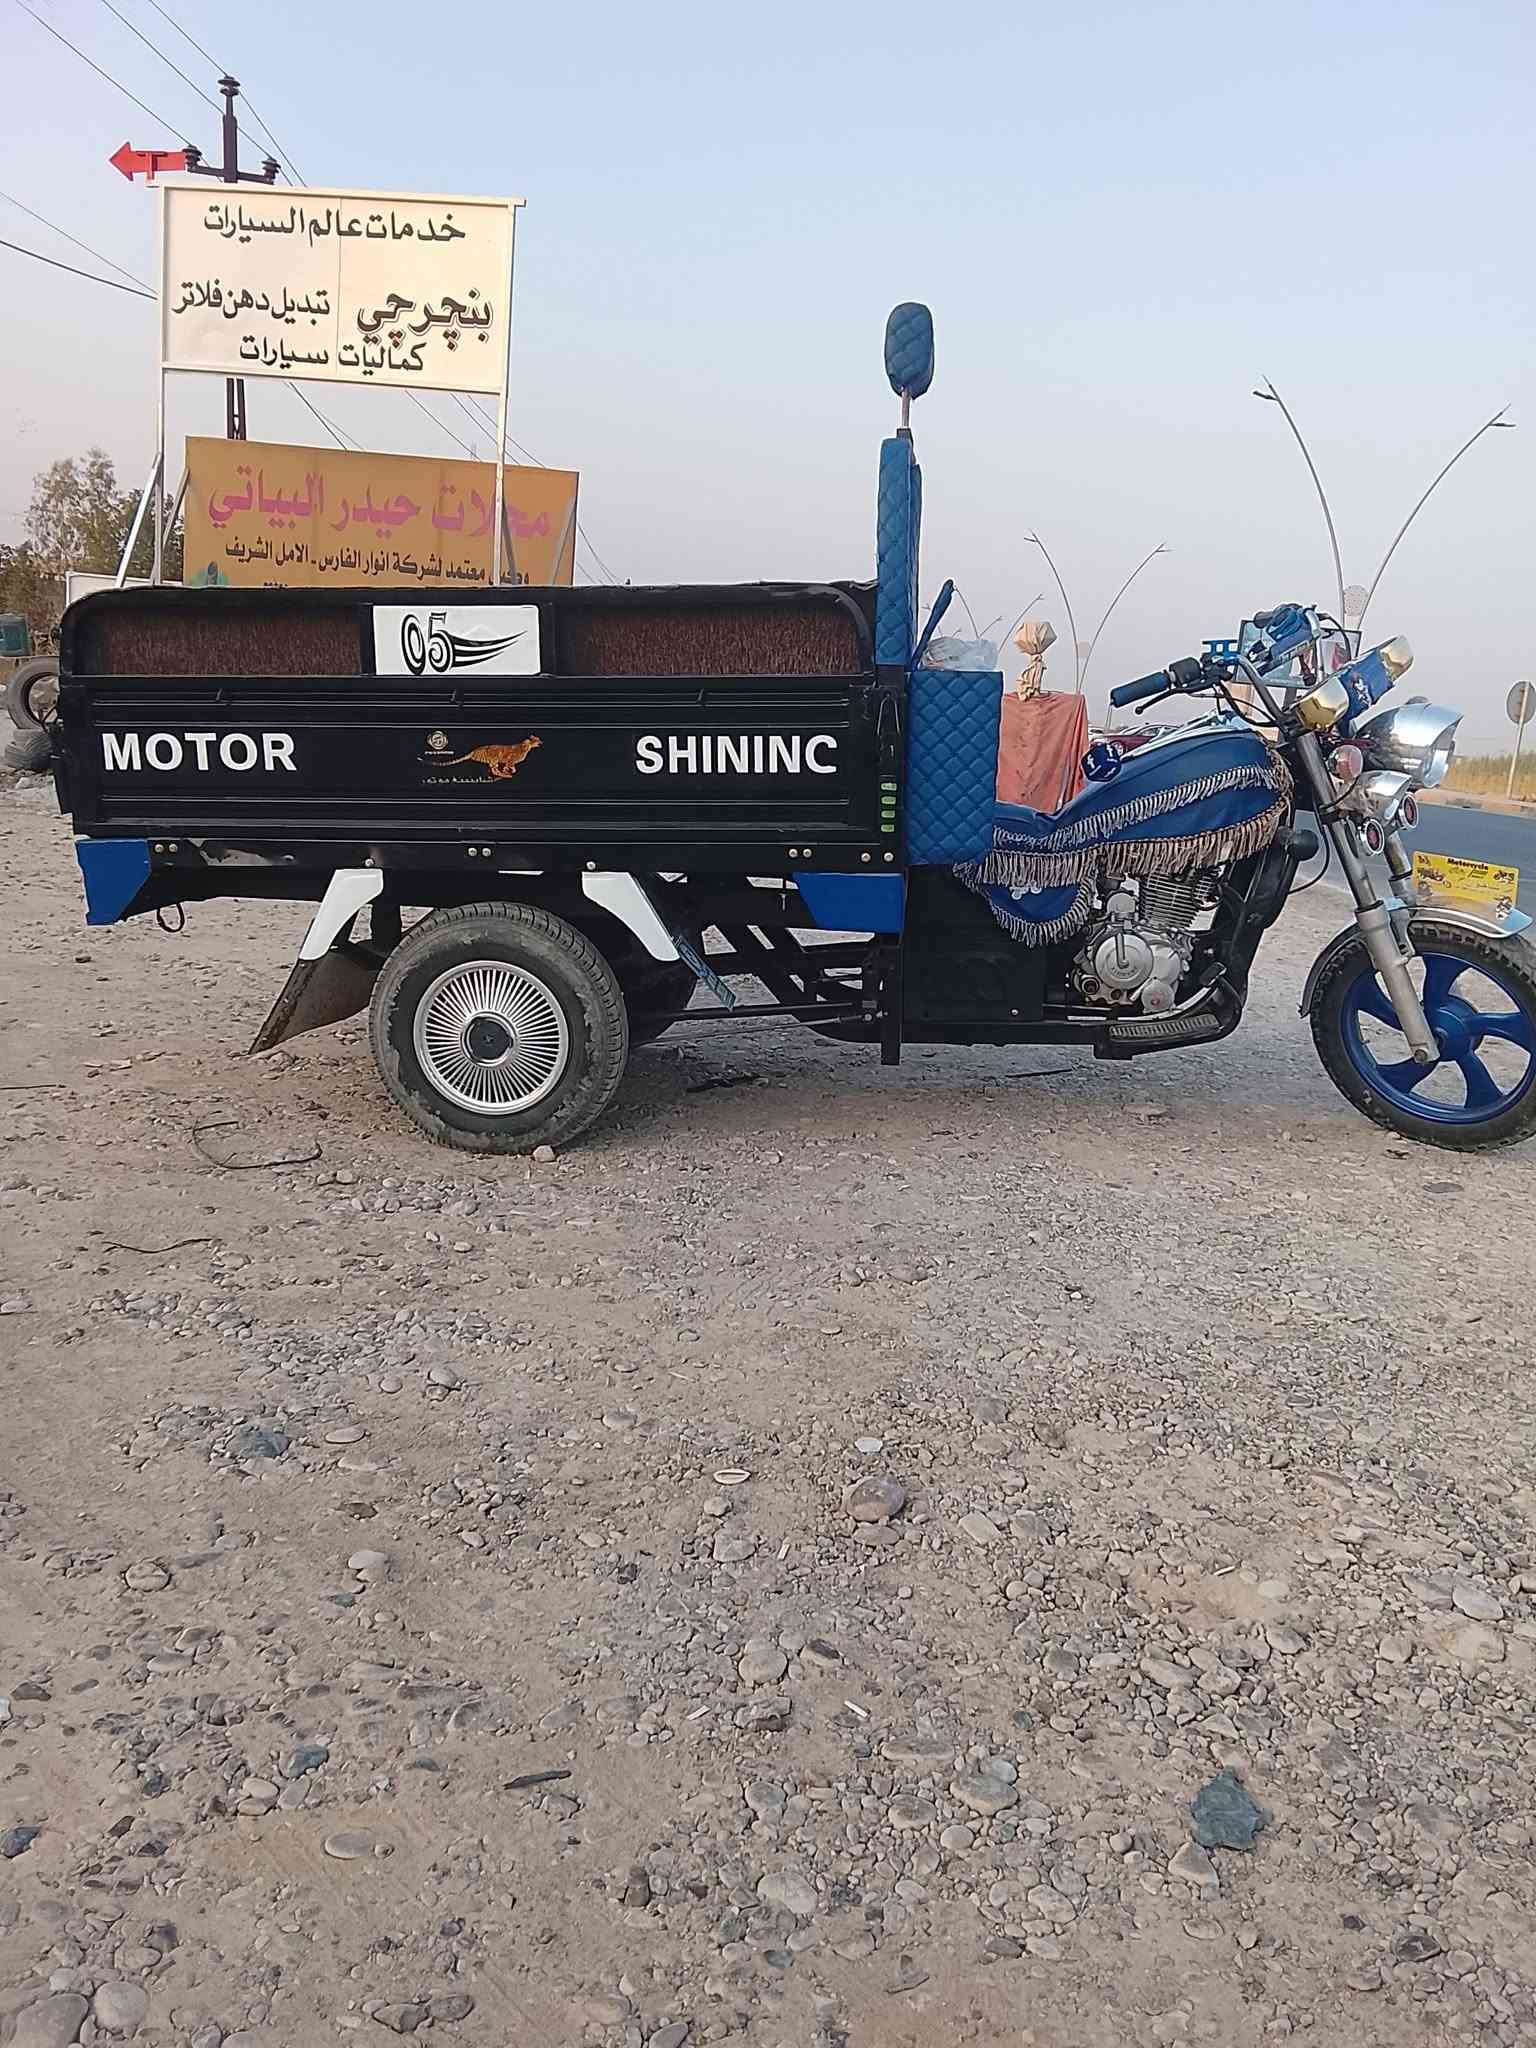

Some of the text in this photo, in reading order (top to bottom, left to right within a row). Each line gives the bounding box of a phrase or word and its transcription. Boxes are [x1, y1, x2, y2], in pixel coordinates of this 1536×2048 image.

[204, 205, 466, 247] خدمات عالم السيارات
[171, 278, 330, 326] تبديل دهن فلاتر
[239, 335, 426, 376] كماليات سيارات
[330, 484, 421, 540] حيدر
[225, 536, 273, 562] الشريف
[275, 543, 309, 566] الامل
[319, 547, 360, 571] الفارس
[362, 550, 389, 576] انوار
[392, 551, 442, 580] لشركة
[446, 557, 486, 581] معتمد
[401, 612, 453, 675] 05
[102, 733, 297, 771] MOTOR
